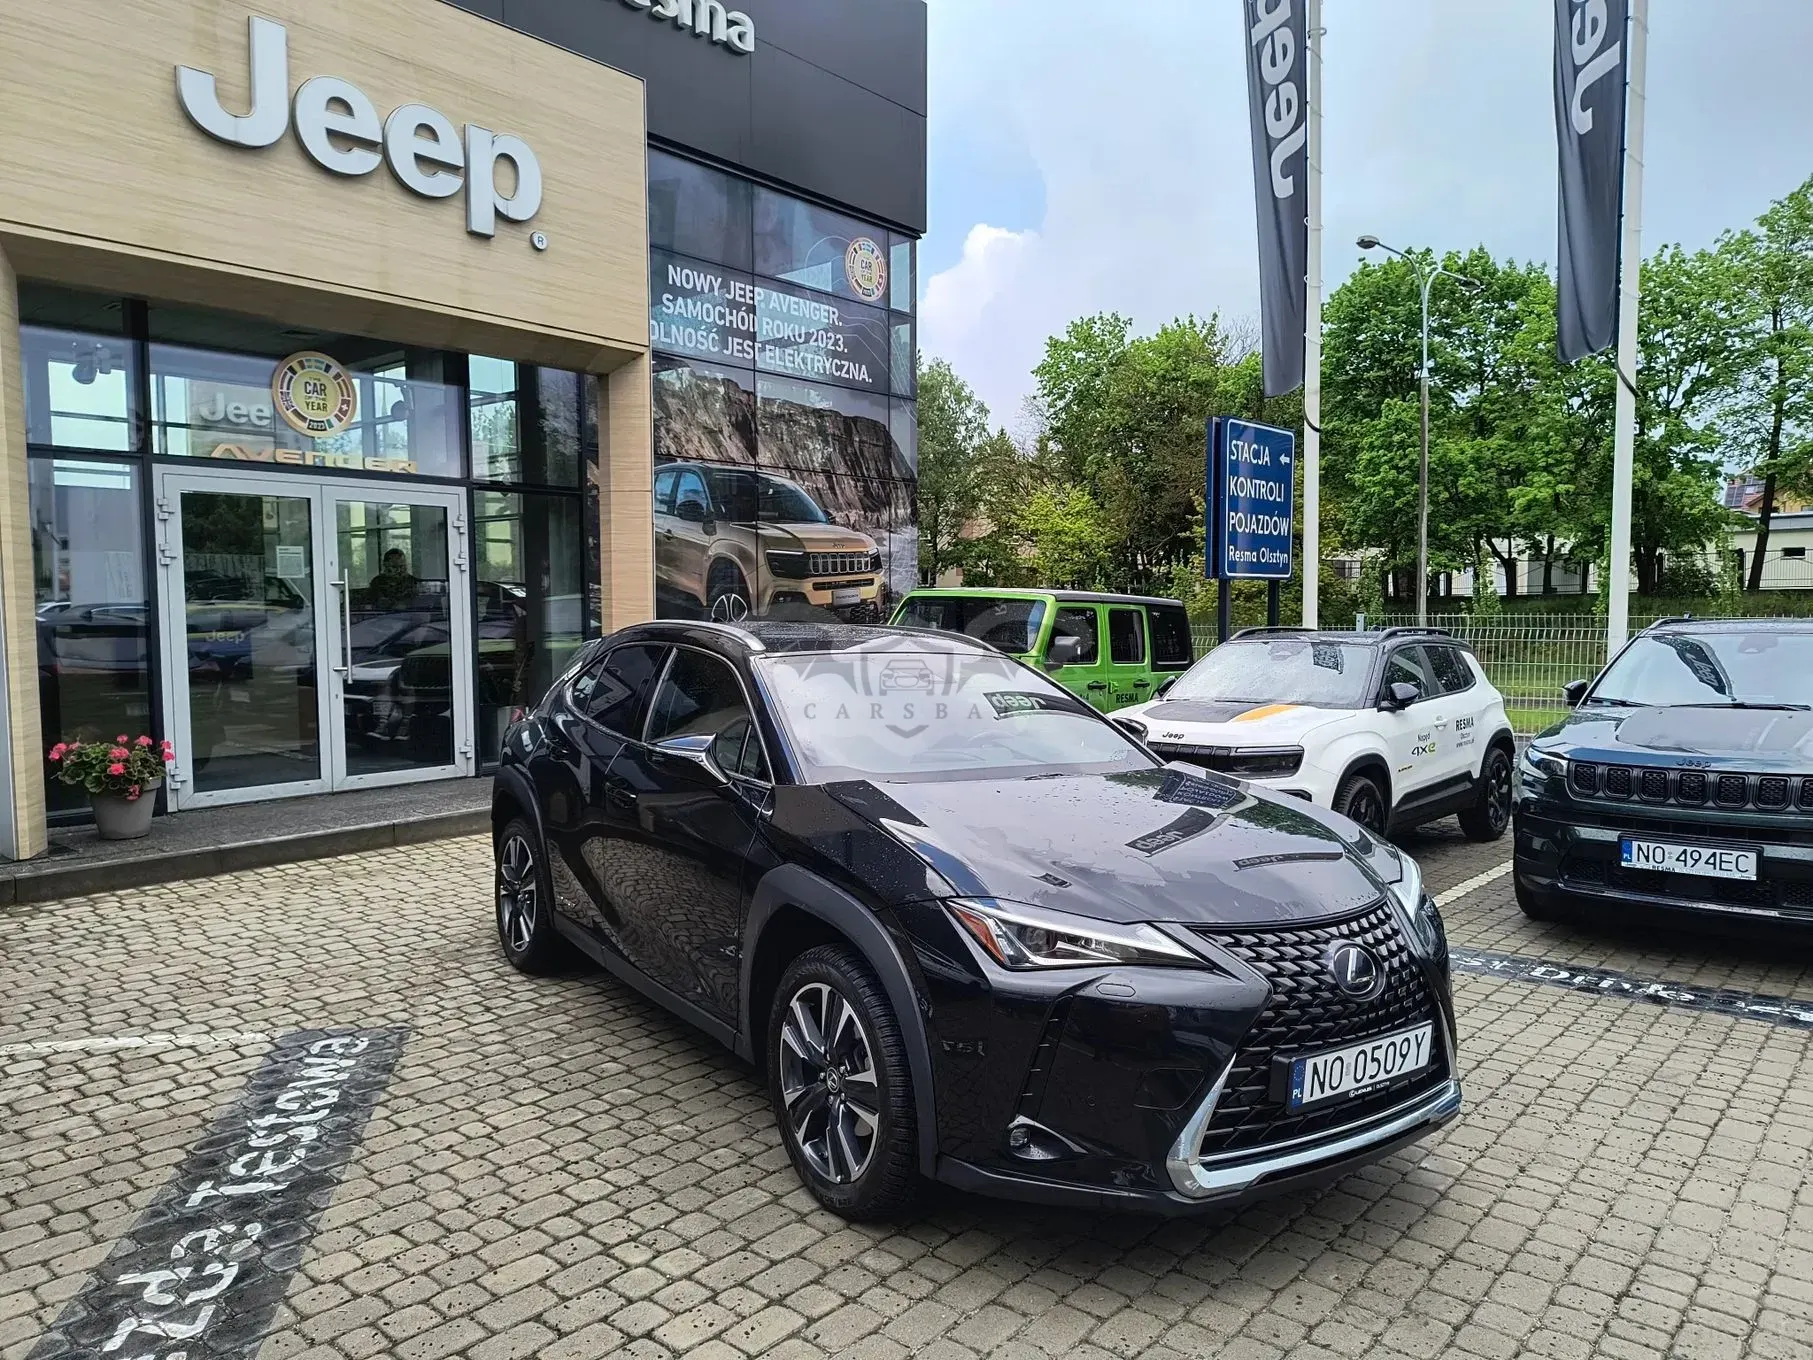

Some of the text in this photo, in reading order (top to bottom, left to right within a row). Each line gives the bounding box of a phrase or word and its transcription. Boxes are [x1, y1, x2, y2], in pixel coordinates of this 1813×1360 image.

[174, 15, 542, 238] Jeep
[667, 264, 722, 297] NOWY
[769, 291, 843, 326] AVENGER.
[661, 293, 848, 353] SAMOCHÓD ROKU 2023.
[650, 319, 873, 384] OLNOŚĆ JEST ELEKTRYCZNA.
[304, 381, 327, 396] CAR
[200, 392, 272, 426] Jee
[304, 400, 328, 412] YEAR
[1230, 439, 1271, 467] STACJA
[1229, 475, 1284, 503] KONTROLI
[1229, 510, 1290, 537] POJAZDÓW
[1228, 545, 1289, 568] Resma Olsztyn
[1115, 692, 1139, 704] RESMA
[1162, 731, 1185, 740] Jeep
[1455, 716, 1475, 731] RESMA
[1675, 757, 1712, 769] Jeep
[1636, 843, 1666, 865] NO
[1675, 848, 1750, 874] 494EC
[1309, 1031, 1427, 1098] NO 0509Y
[1292, 1087, 1302, 1099] PL
